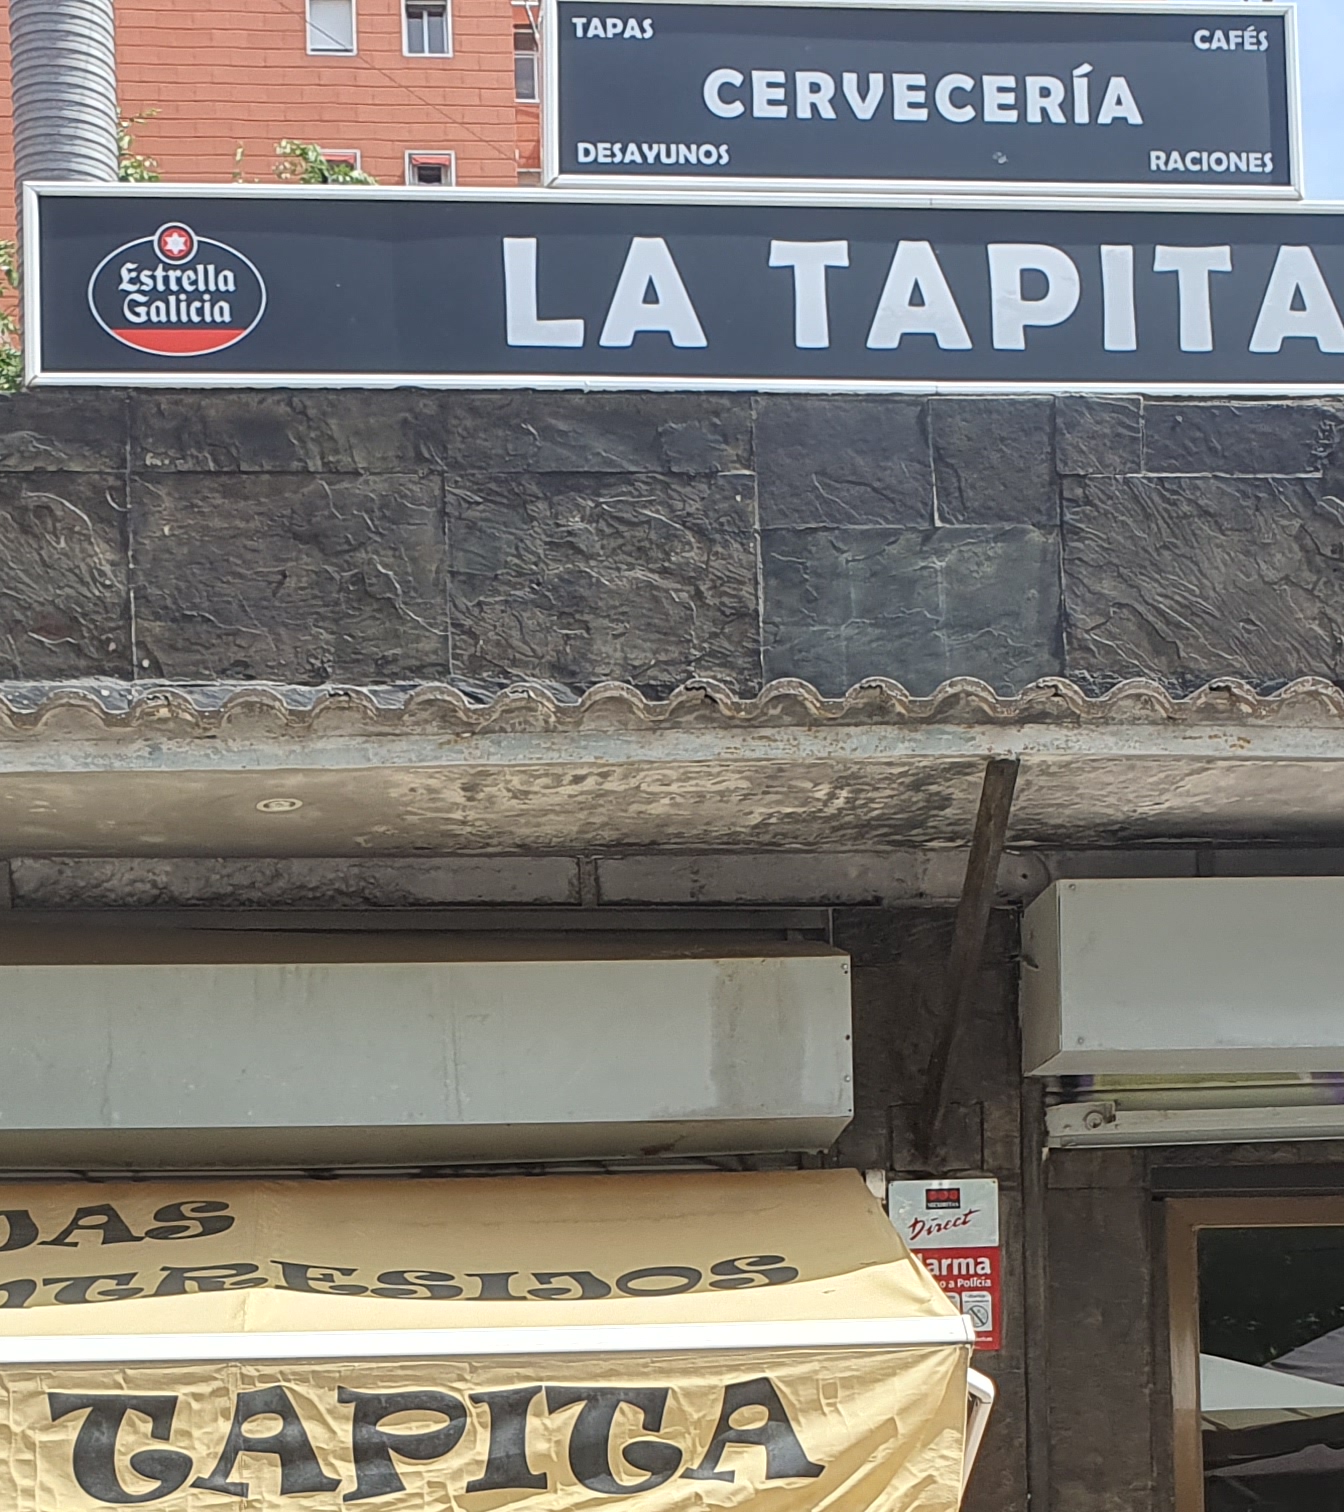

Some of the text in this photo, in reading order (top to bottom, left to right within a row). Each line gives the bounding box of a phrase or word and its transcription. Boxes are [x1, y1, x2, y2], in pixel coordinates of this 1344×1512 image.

[571, 17, 654, 40] TAPAS
[1193, 25, 1269, 51] CAFÉS
[703, 62, 1144, 125] CERVECERÍA
[576, 142, 730, 165] DESAYUNOS
[1149, 150, 1274, 173] RACIONES
[118, 262, 236, 292] Estrella
[502, 236, 708, 348] LA
[123, 292, 232, 324] Galicia
[908, 1208, 982, 1241] Direct
[917, 1253, 992, 1276] arma
[47, 1375, 825, 1505] TAPITA
